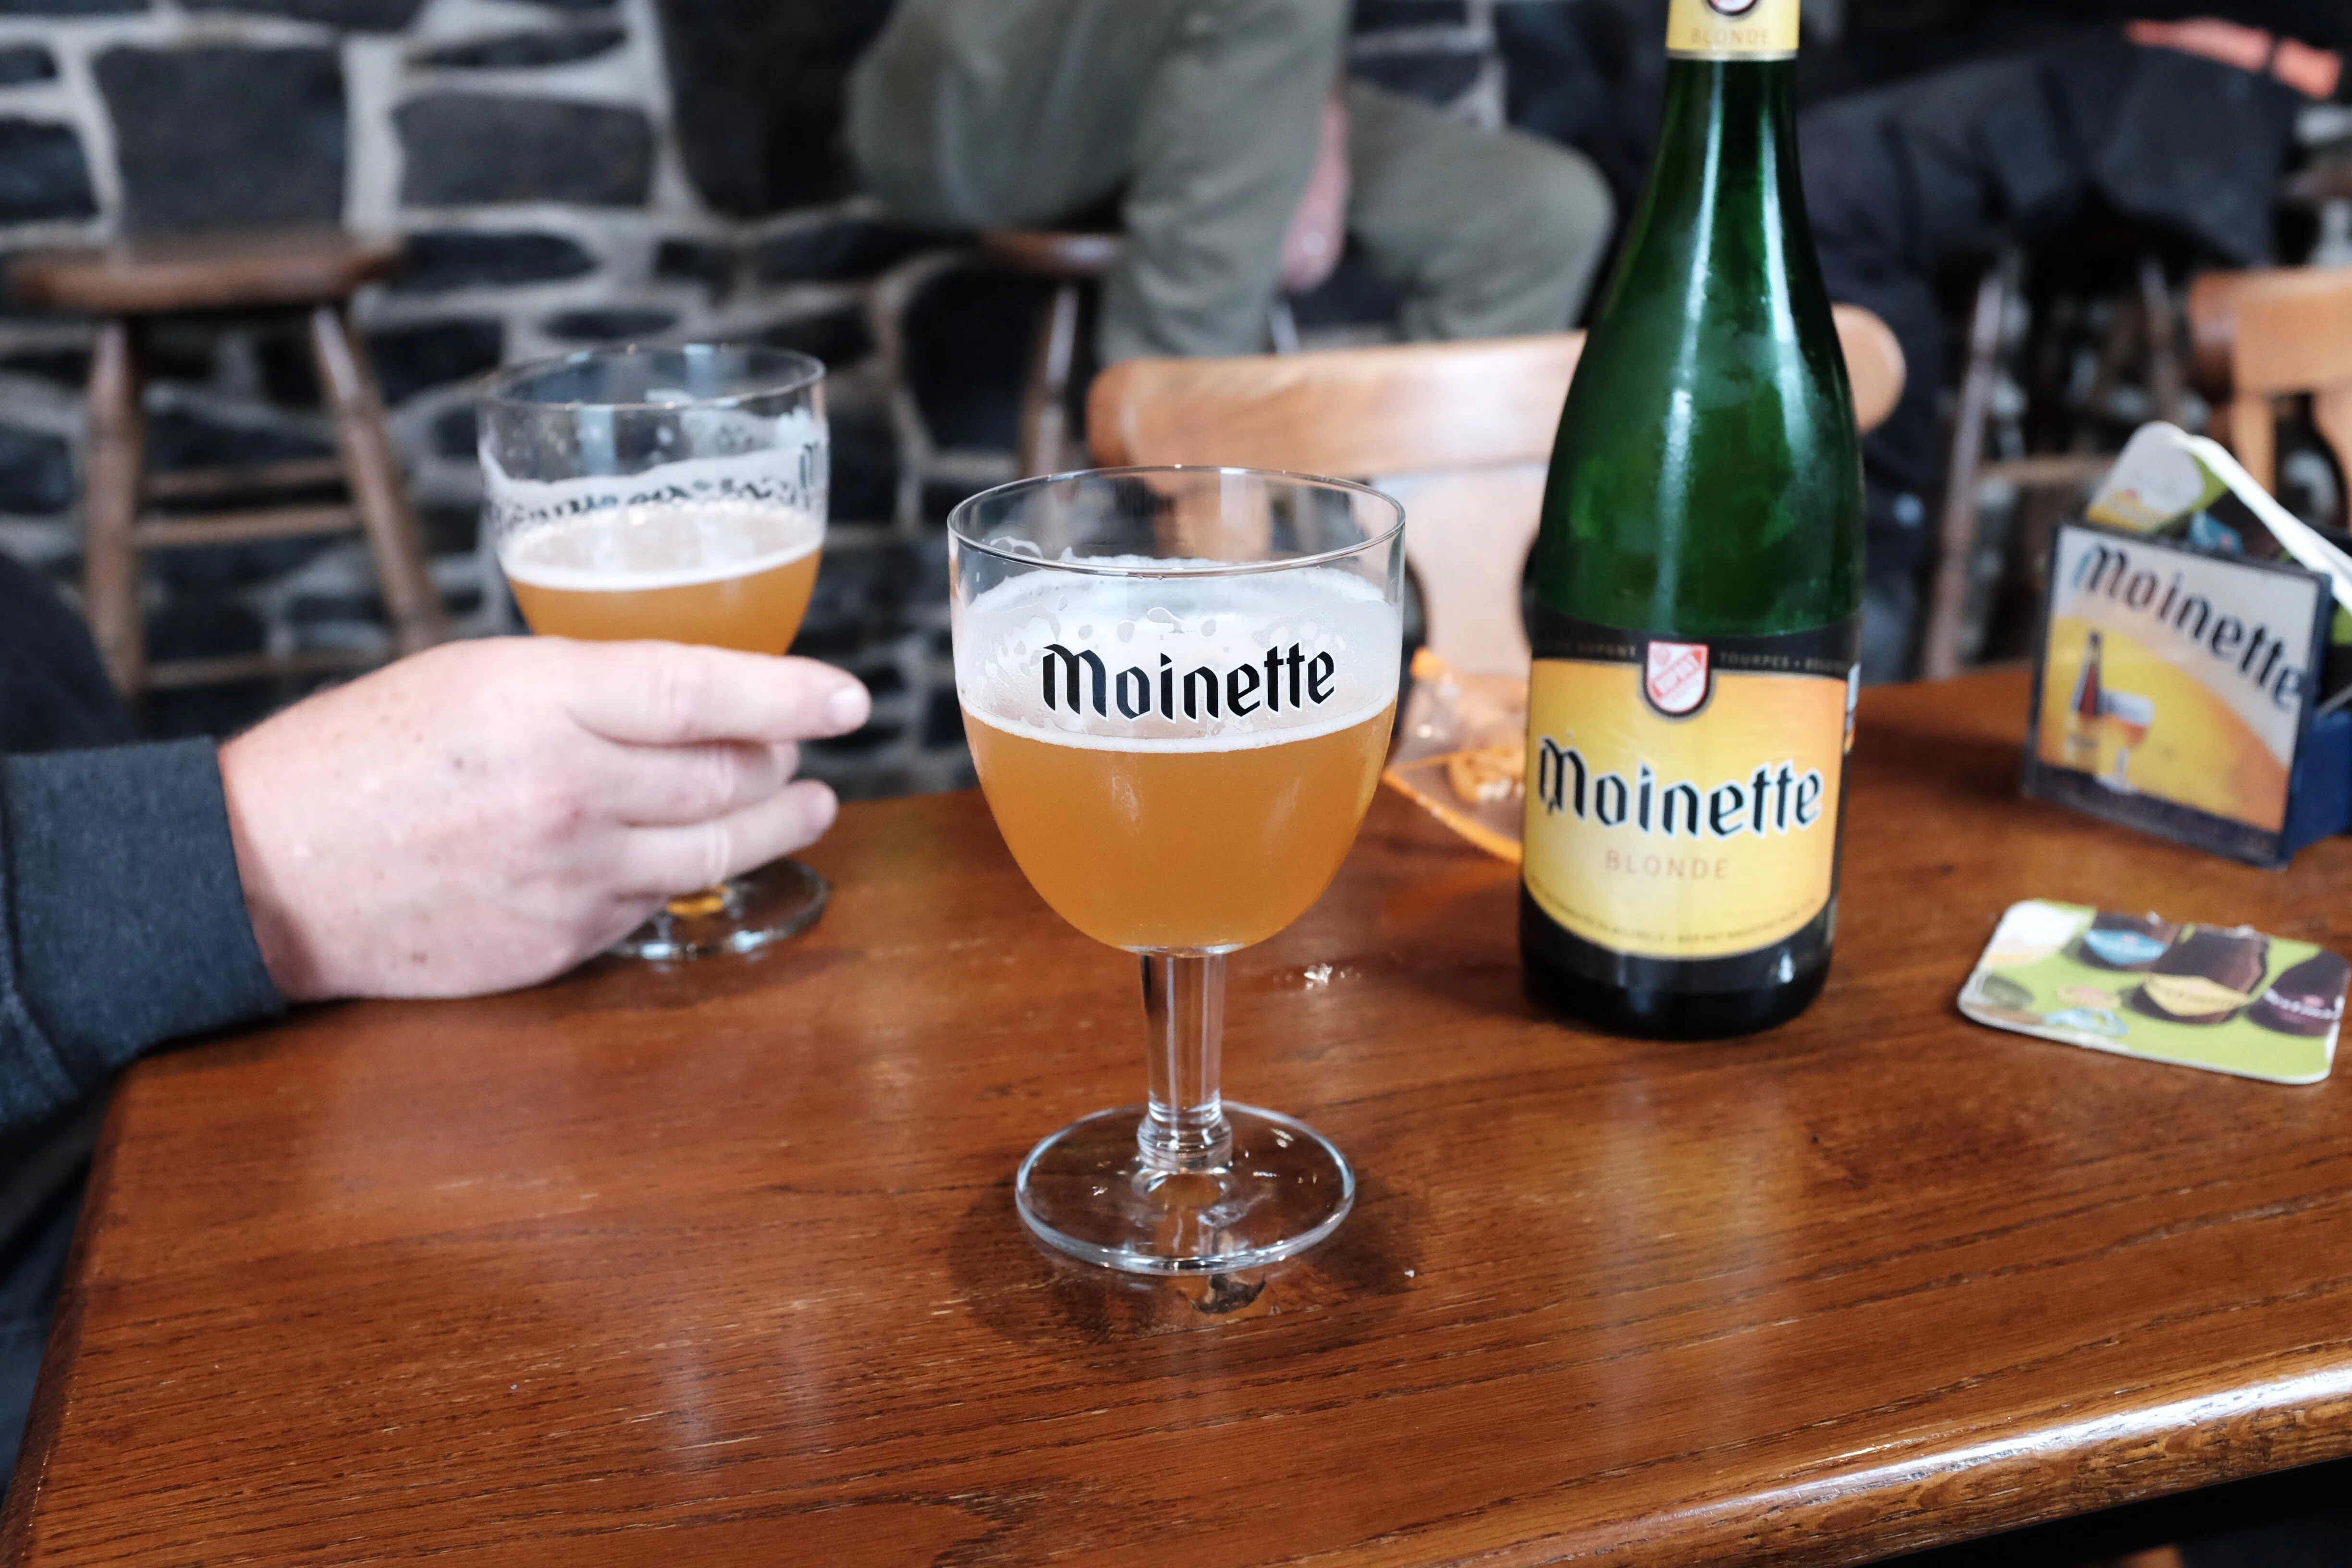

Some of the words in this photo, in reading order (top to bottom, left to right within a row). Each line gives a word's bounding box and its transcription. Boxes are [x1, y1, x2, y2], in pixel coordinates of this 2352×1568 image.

[1690, 28, 1770, 45] BLONDE
[2073, 541, 2304, 711] Moinette
[1042, 641, 1335, 723] Moinette
[1538, 737, 1823, 839] Moinette
[1605, 849, 1728, 880] BLONDE
